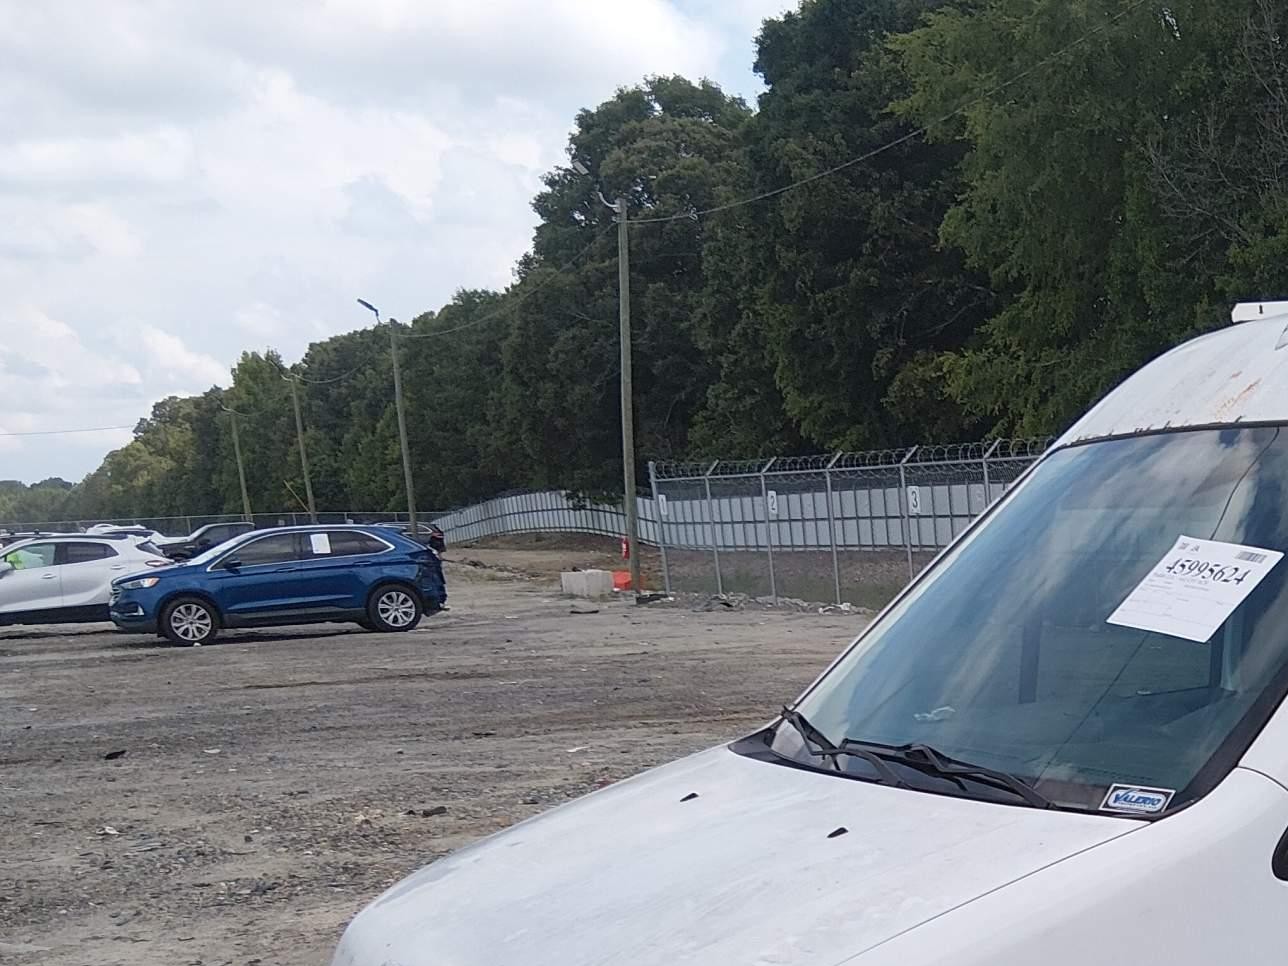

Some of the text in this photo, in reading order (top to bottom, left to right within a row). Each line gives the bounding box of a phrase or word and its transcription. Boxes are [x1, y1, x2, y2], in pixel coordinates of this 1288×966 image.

[770, 495, 776, 511] 2
[911, 490, 918, 508] 3
[1165, 558, 1252, 585] 45995624
